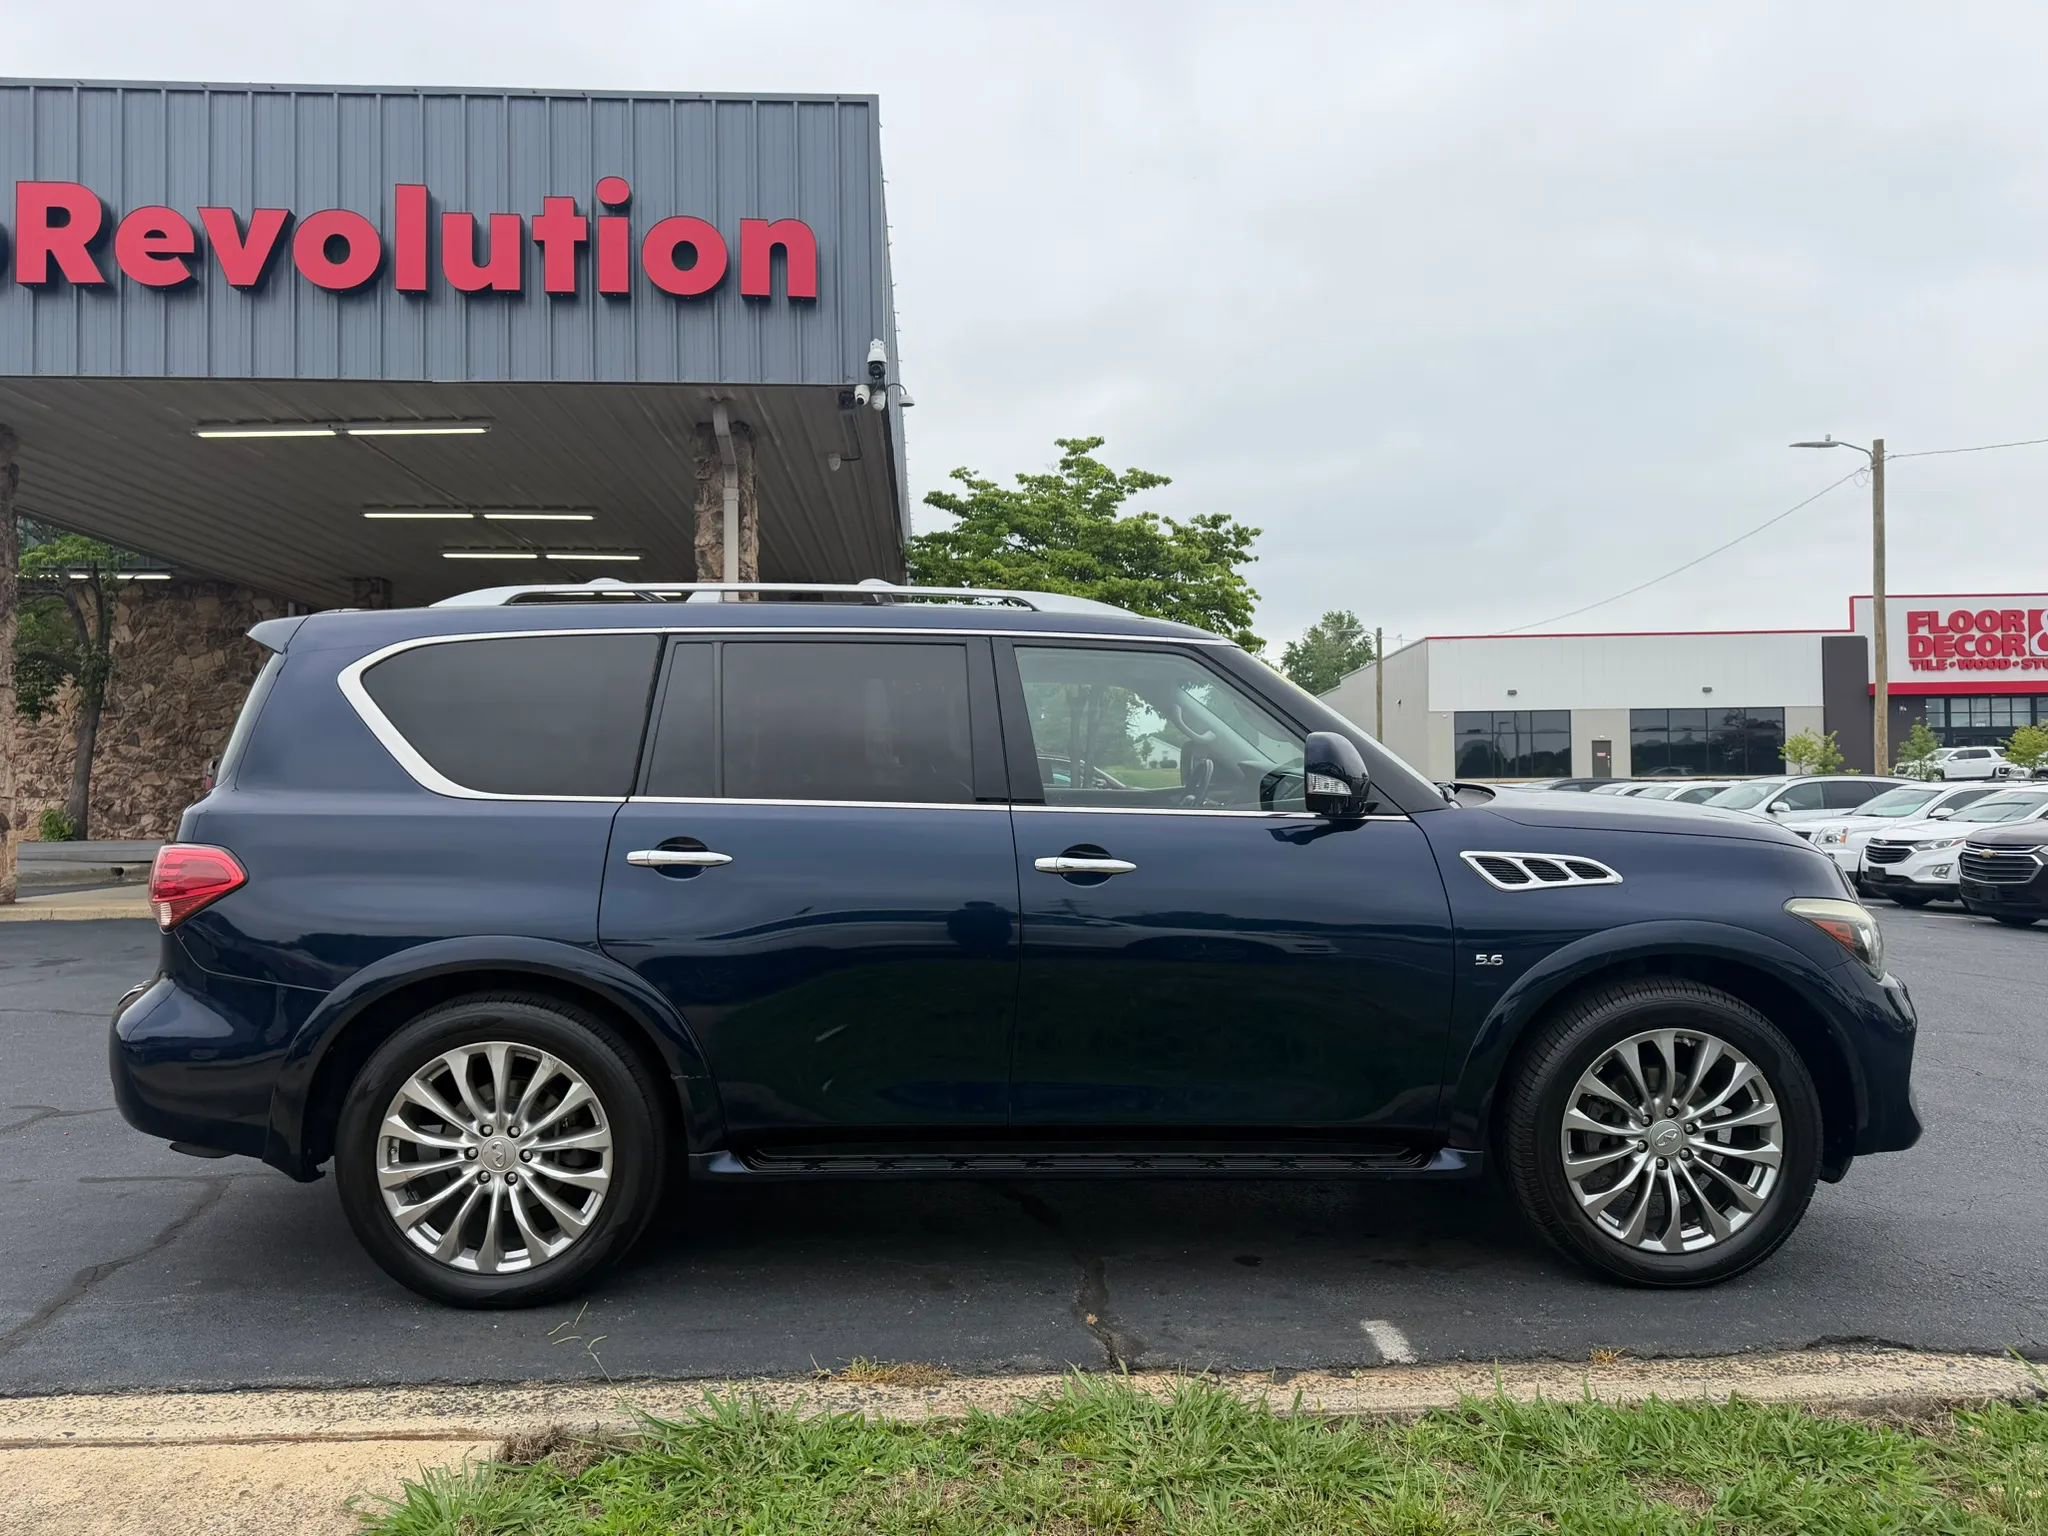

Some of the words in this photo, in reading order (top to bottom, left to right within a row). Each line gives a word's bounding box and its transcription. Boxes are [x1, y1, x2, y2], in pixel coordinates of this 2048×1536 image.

[16, 176, 818, 301] Revolution
[1907, 610, 2026, 635] FLOOR
[1908, 634, 2027, 659] DECOR
[1909, 659, 1949, 672] TILE
[1957, 658, 2012, 671] WOOD
[1475, 954, 1504, 966] 5.6
